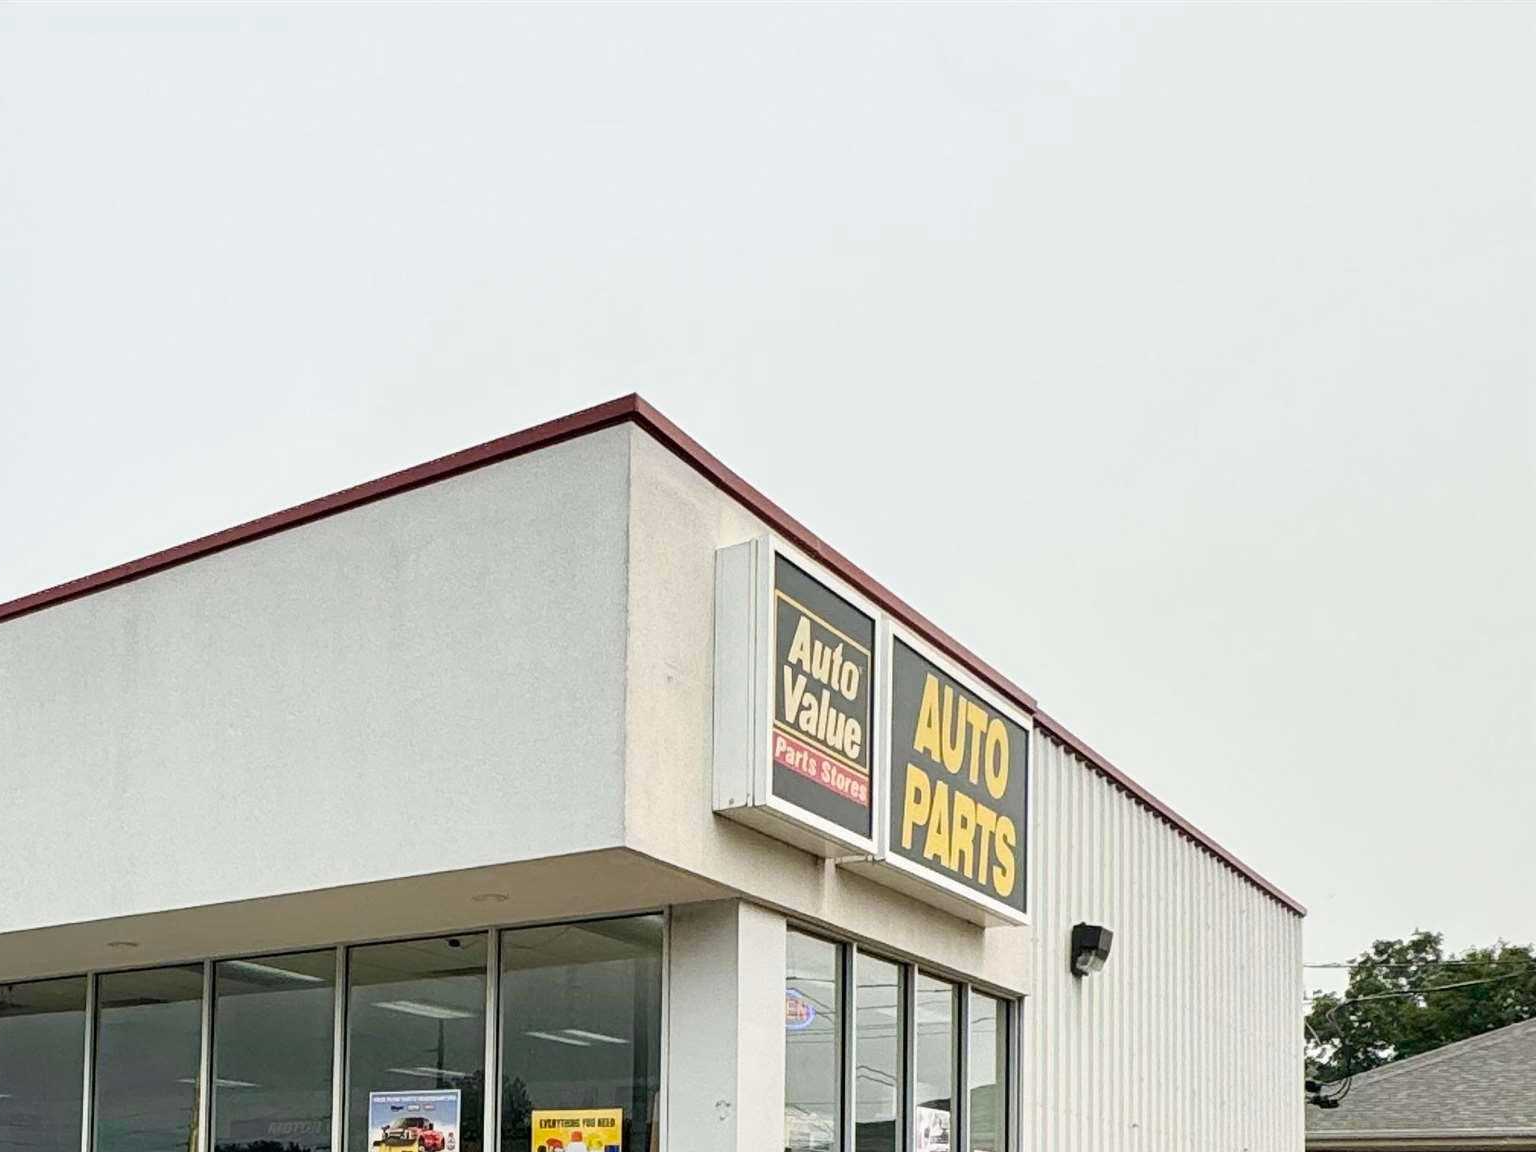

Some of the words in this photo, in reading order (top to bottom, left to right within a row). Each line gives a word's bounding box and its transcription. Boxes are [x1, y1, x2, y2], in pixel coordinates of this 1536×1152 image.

[787, 615, 860, 701] Auto
[783, 665, 862, 759] Value
[913, 672, 1009, 799] AUTO
[775, 736, 817, 777] Parts
[820, 760, 868, 802] Stores
[901, 762, 1016, 897] PARTS
